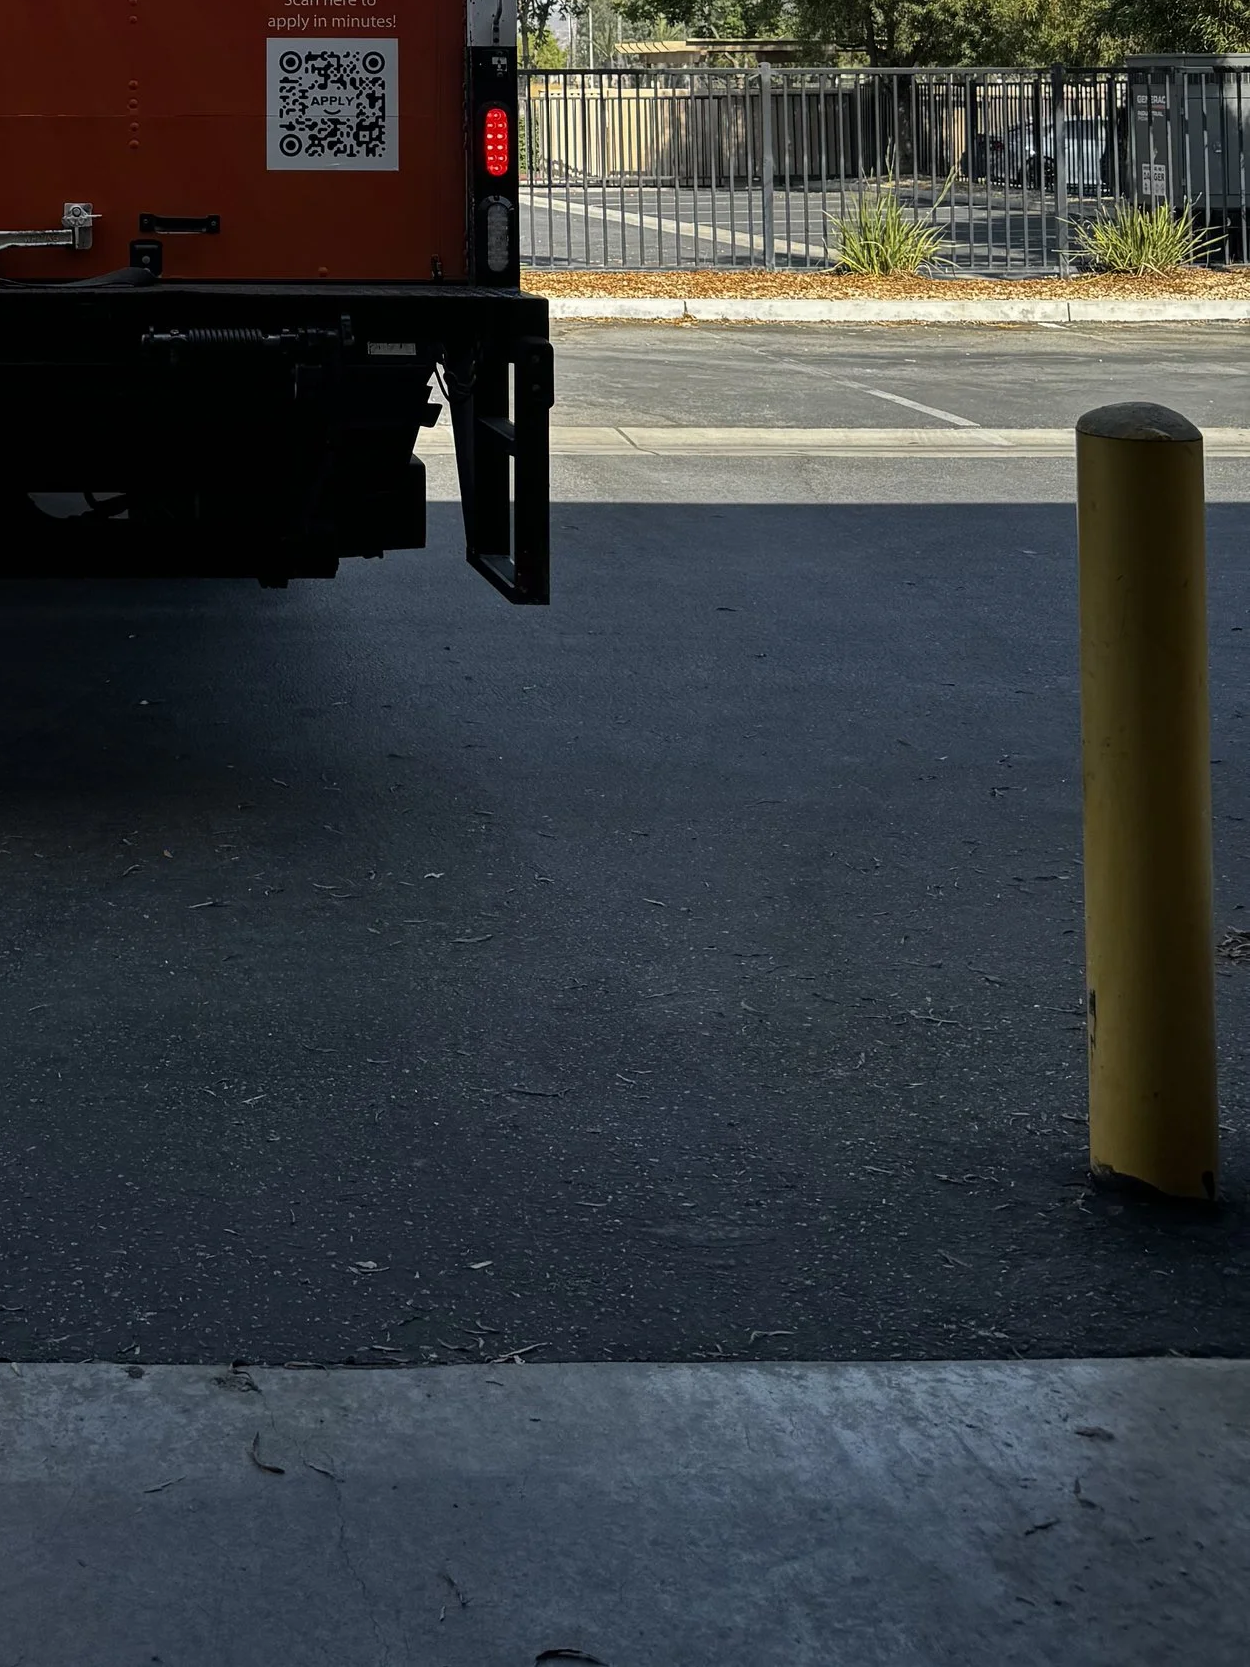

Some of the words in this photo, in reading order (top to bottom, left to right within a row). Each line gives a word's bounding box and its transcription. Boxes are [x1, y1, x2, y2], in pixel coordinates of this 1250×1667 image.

[267, 14, 310, 30] apply
[313, 14, 327, 27] in
[332, 15, 396, 28] minutes!
[310, 96, 355, 106] APPLY
